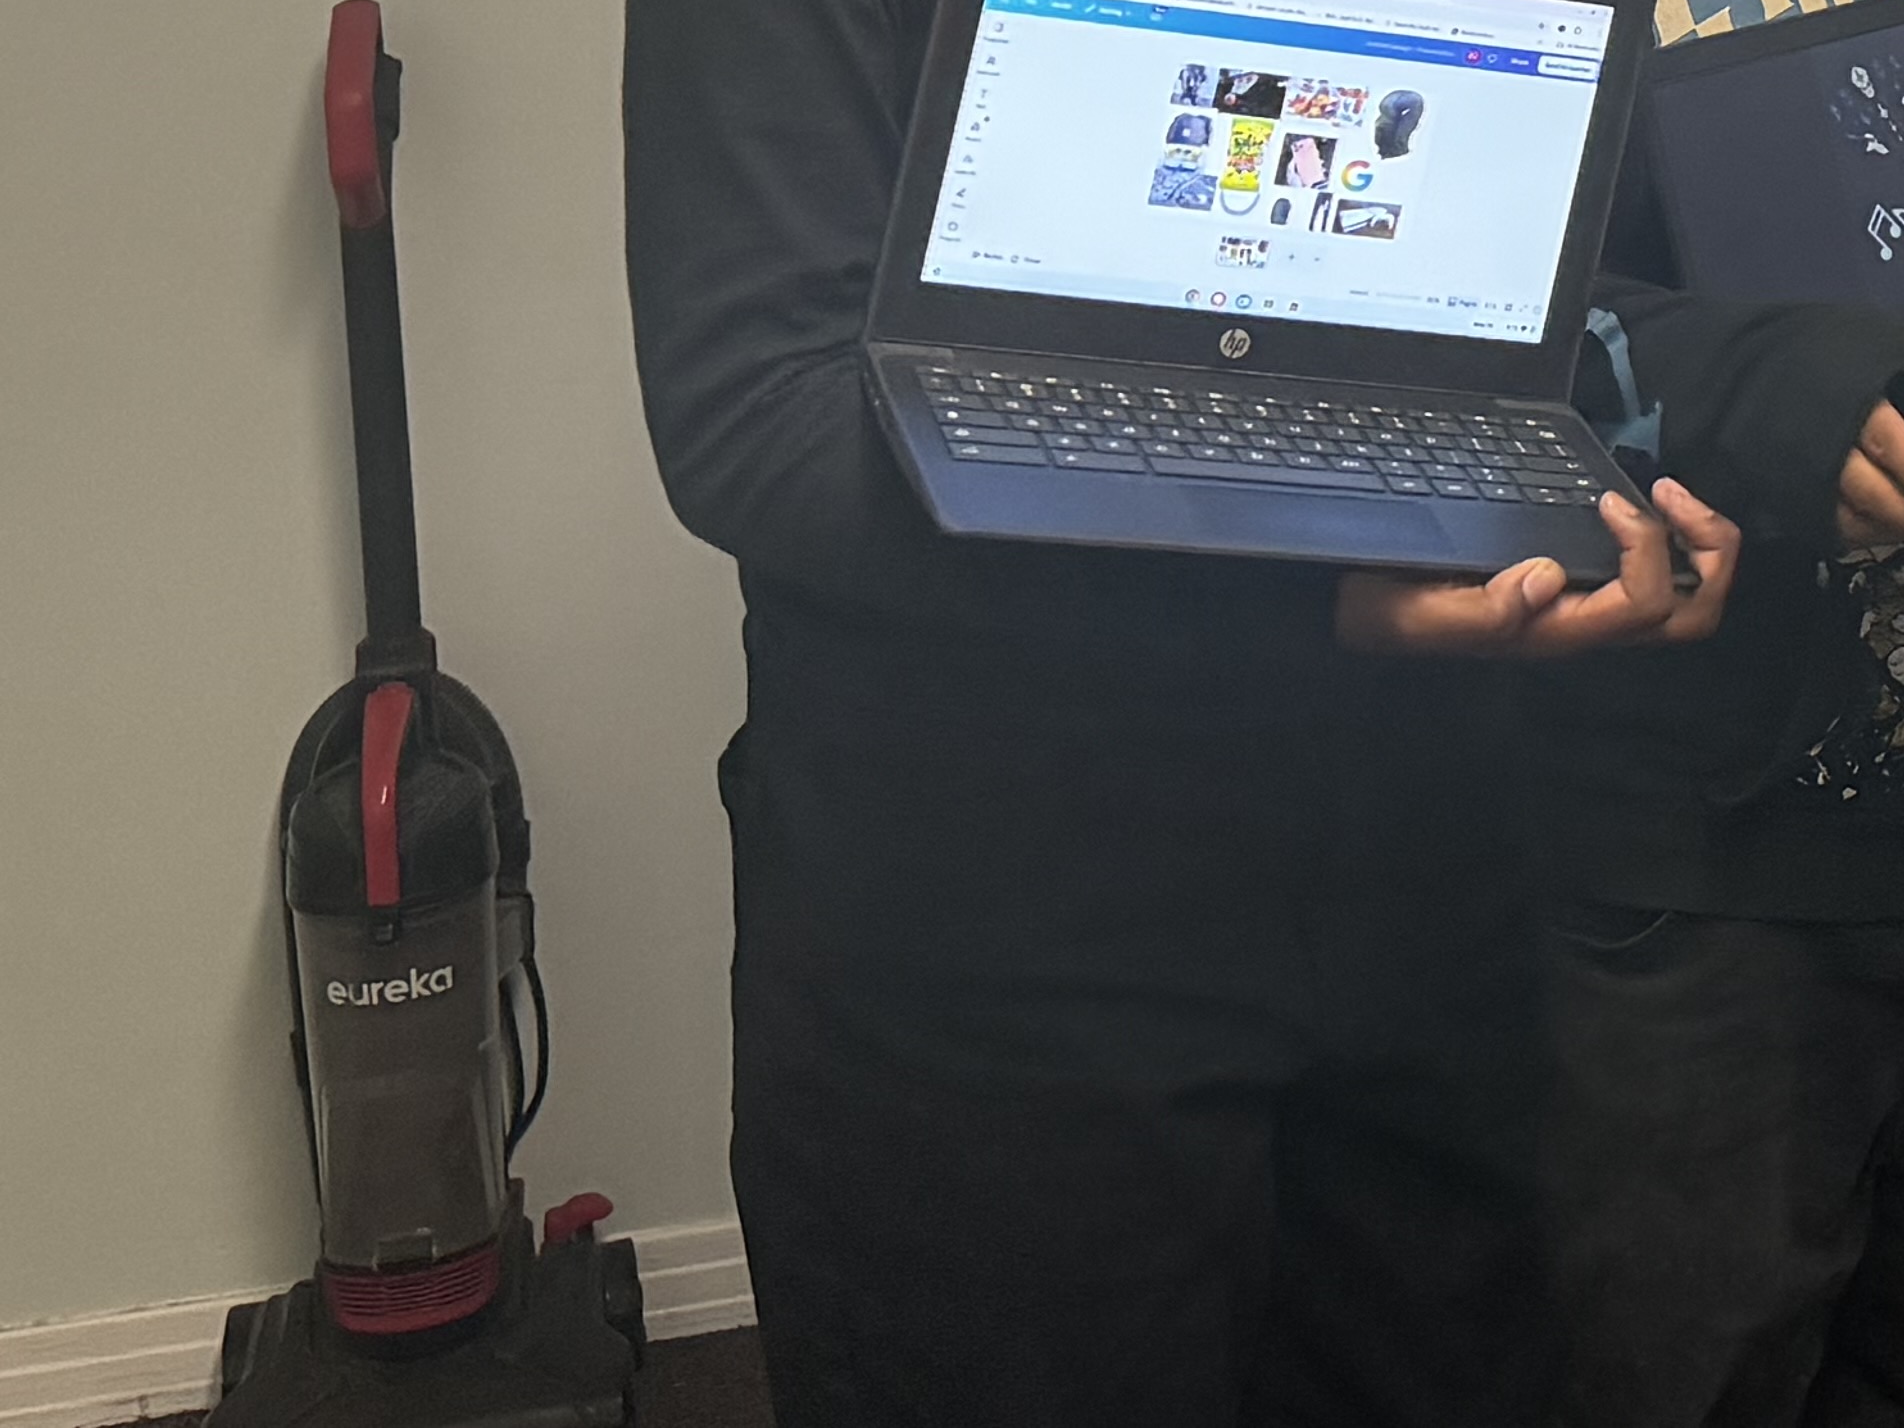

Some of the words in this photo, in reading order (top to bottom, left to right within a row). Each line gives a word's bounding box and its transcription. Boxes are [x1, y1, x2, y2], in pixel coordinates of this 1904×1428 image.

[1341, 160, 1374, 192] G
[1223, 328, 1249, 358] hp
[326, 964, 455, 1007] eureka
